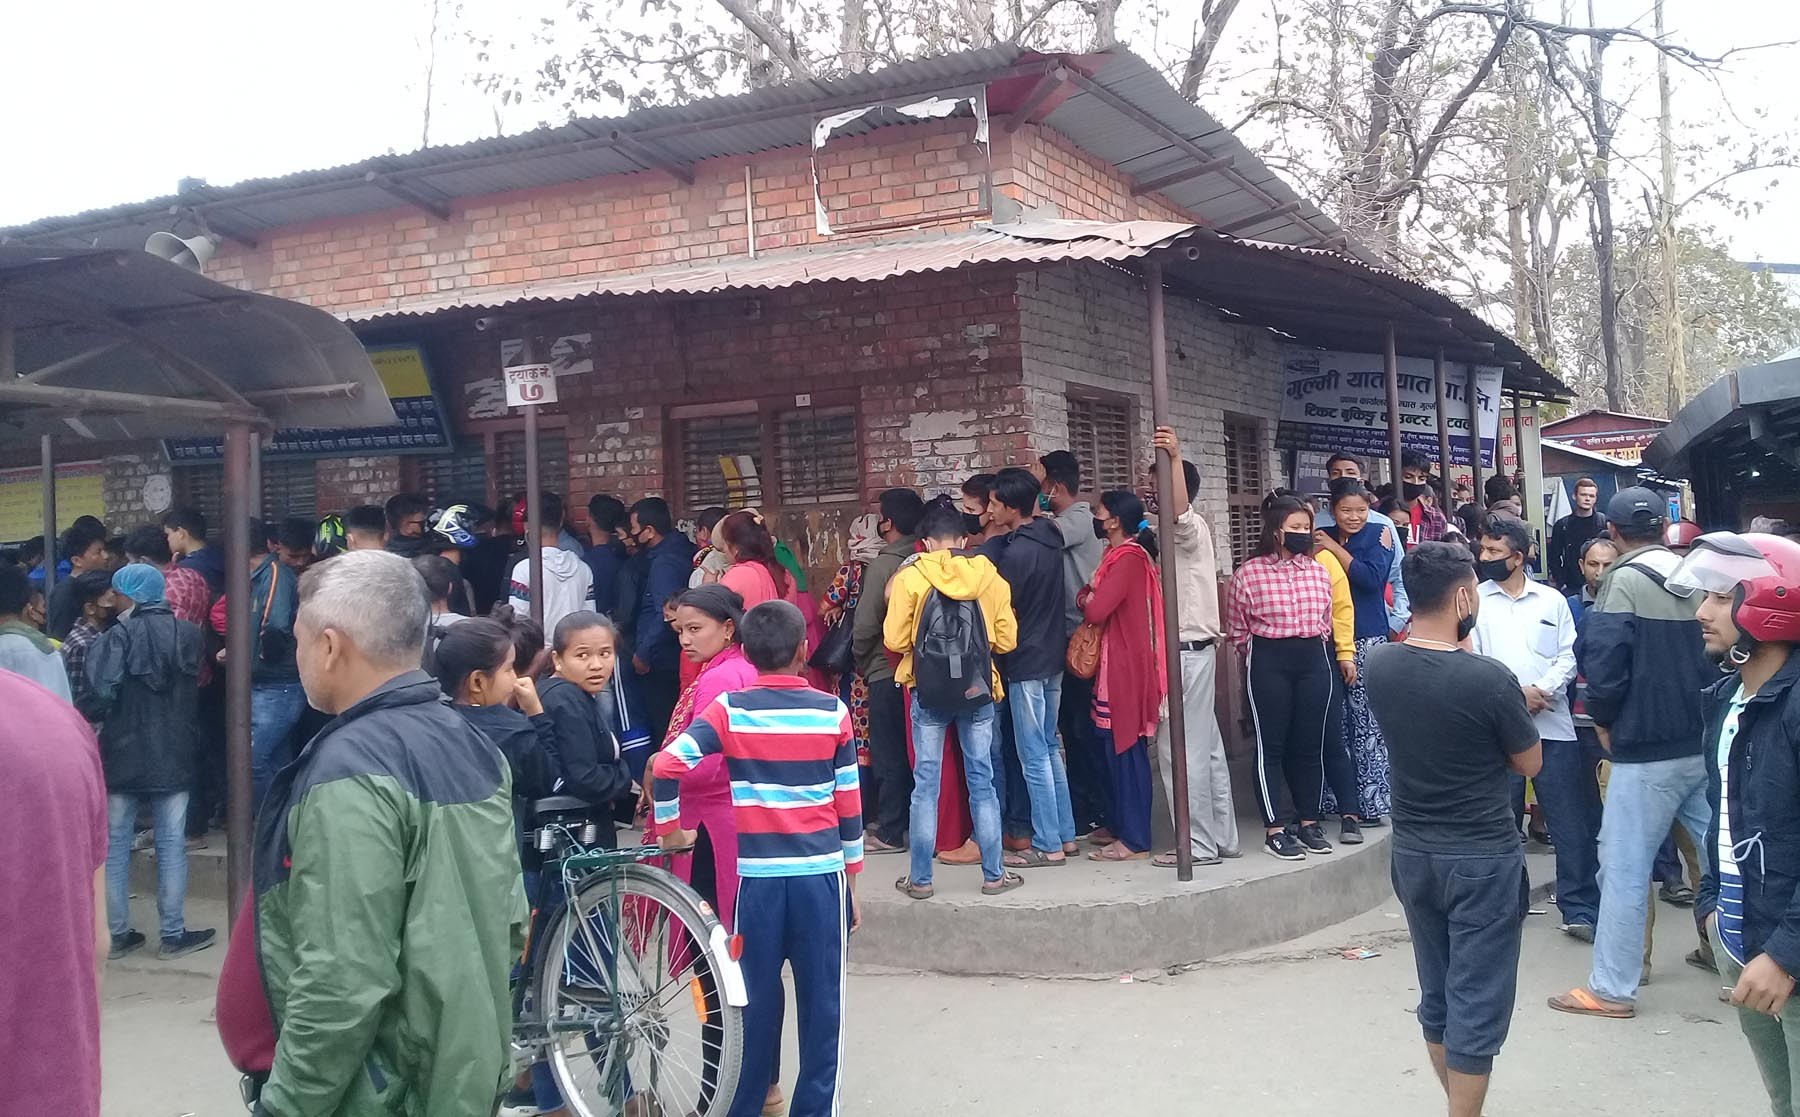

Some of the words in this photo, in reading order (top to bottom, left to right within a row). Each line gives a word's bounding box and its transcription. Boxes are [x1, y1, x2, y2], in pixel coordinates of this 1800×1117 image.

[519, 384, 545, 401] ७
[1286, 369, 1341, 399] गुल्मी
[1346, 372, 1433, 394] यातयात
[1304, 402, 1339, 419] टिकट
